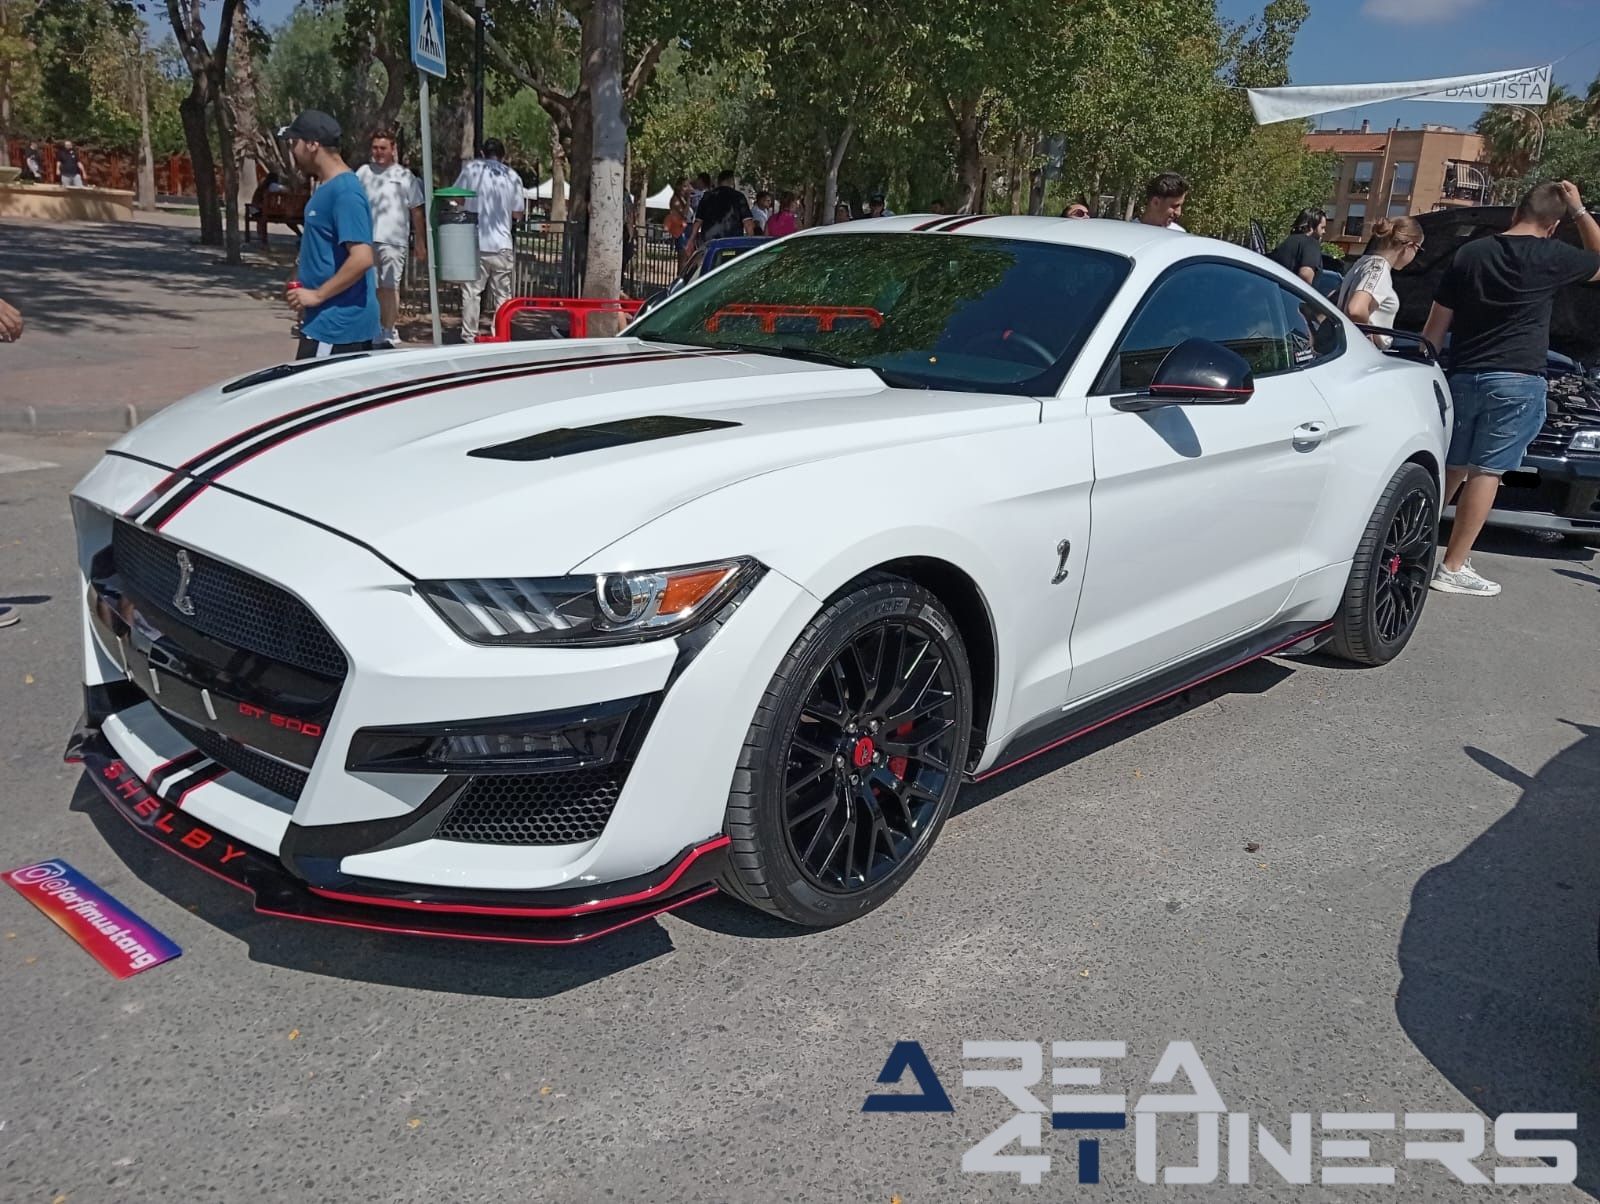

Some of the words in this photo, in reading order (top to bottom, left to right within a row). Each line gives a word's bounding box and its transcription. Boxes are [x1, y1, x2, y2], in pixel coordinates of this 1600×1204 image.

[1445, 82, 1544, 99] BAUTISTA
[239, 702, 264, 718] GT
[270, 712, 321, 736] 500
[103, 759, 246, 864] SHELBY
